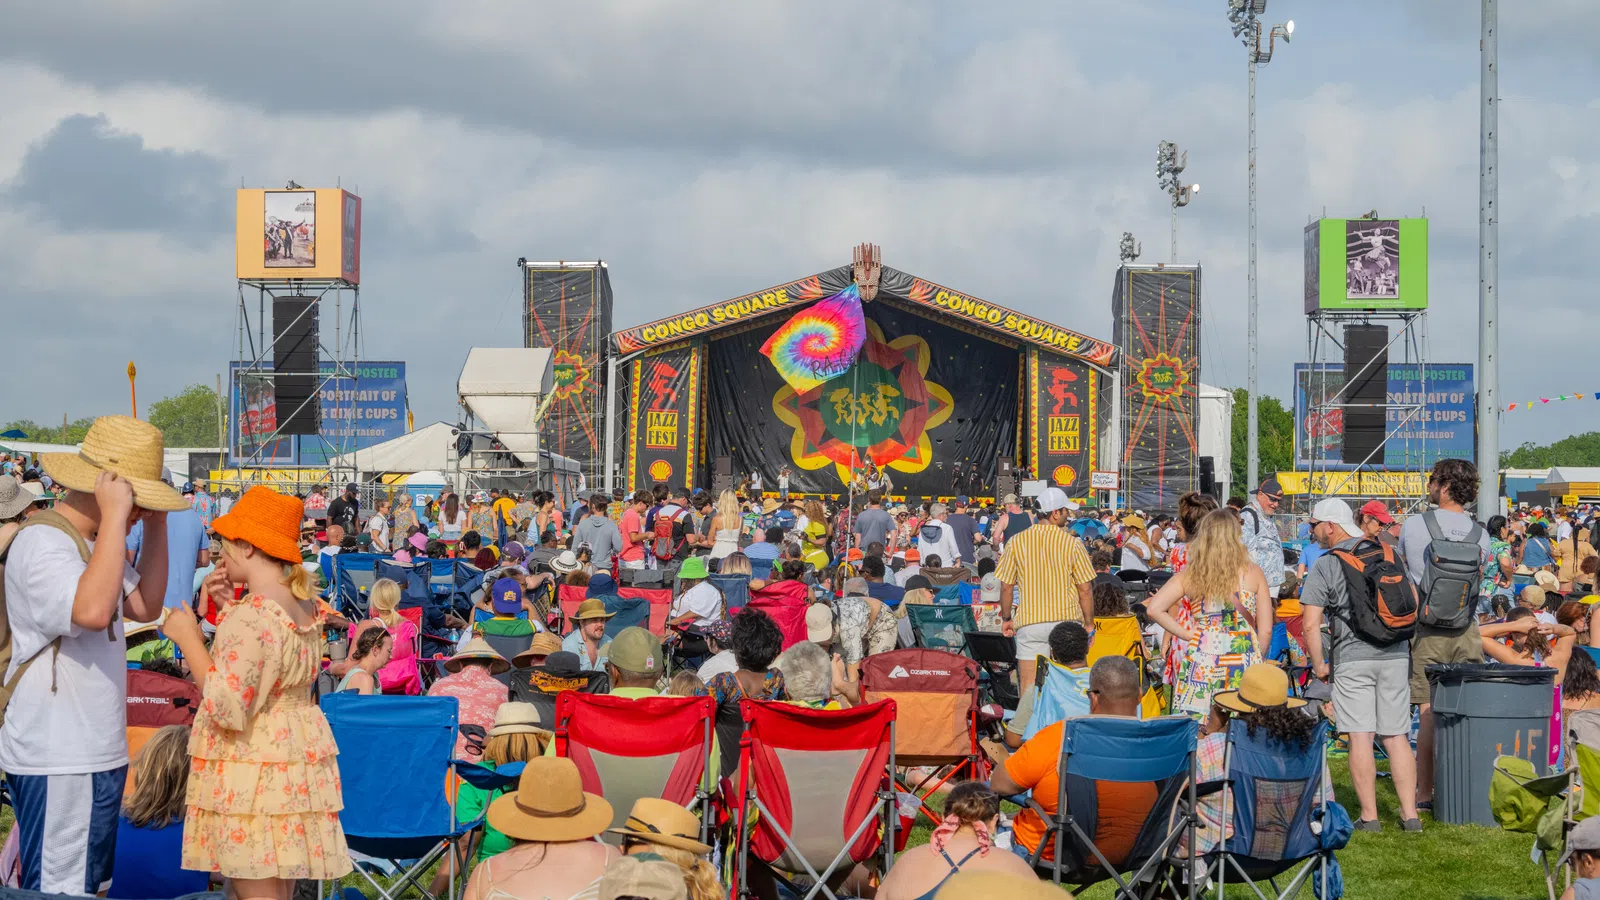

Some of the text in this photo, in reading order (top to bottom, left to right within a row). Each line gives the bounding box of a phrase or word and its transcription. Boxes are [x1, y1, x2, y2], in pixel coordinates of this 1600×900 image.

[643, 289, 790, 343] CONGO SQUARE
[935, 291, 1081, 351] CONGO SQUARE
[355, 367, 398, 379] POSTER
[1423, 370, 1466, 380] POSTER
[320, 390, 397, 401] PORTRAIT OF
[1386, 392, 1465, 404] PORTRAIT OF
[330, 408, 363, 419] DIXIE
[365, 408, 398, 419] CUPS
[1397, 411, 1432, 421] DIXIE
[1434, 411, 1467, 422] CUPS
[647, 412, 677, 428] JAZZ
[1050, 417, 1078, 433] JAZZ
[356, 429, 386, 437] TALBOT
[648, 430, 677, 446] FEST
[1424, 431, 1455, 439] TALBOT
[1050, 435, 1079, 450] FEST
